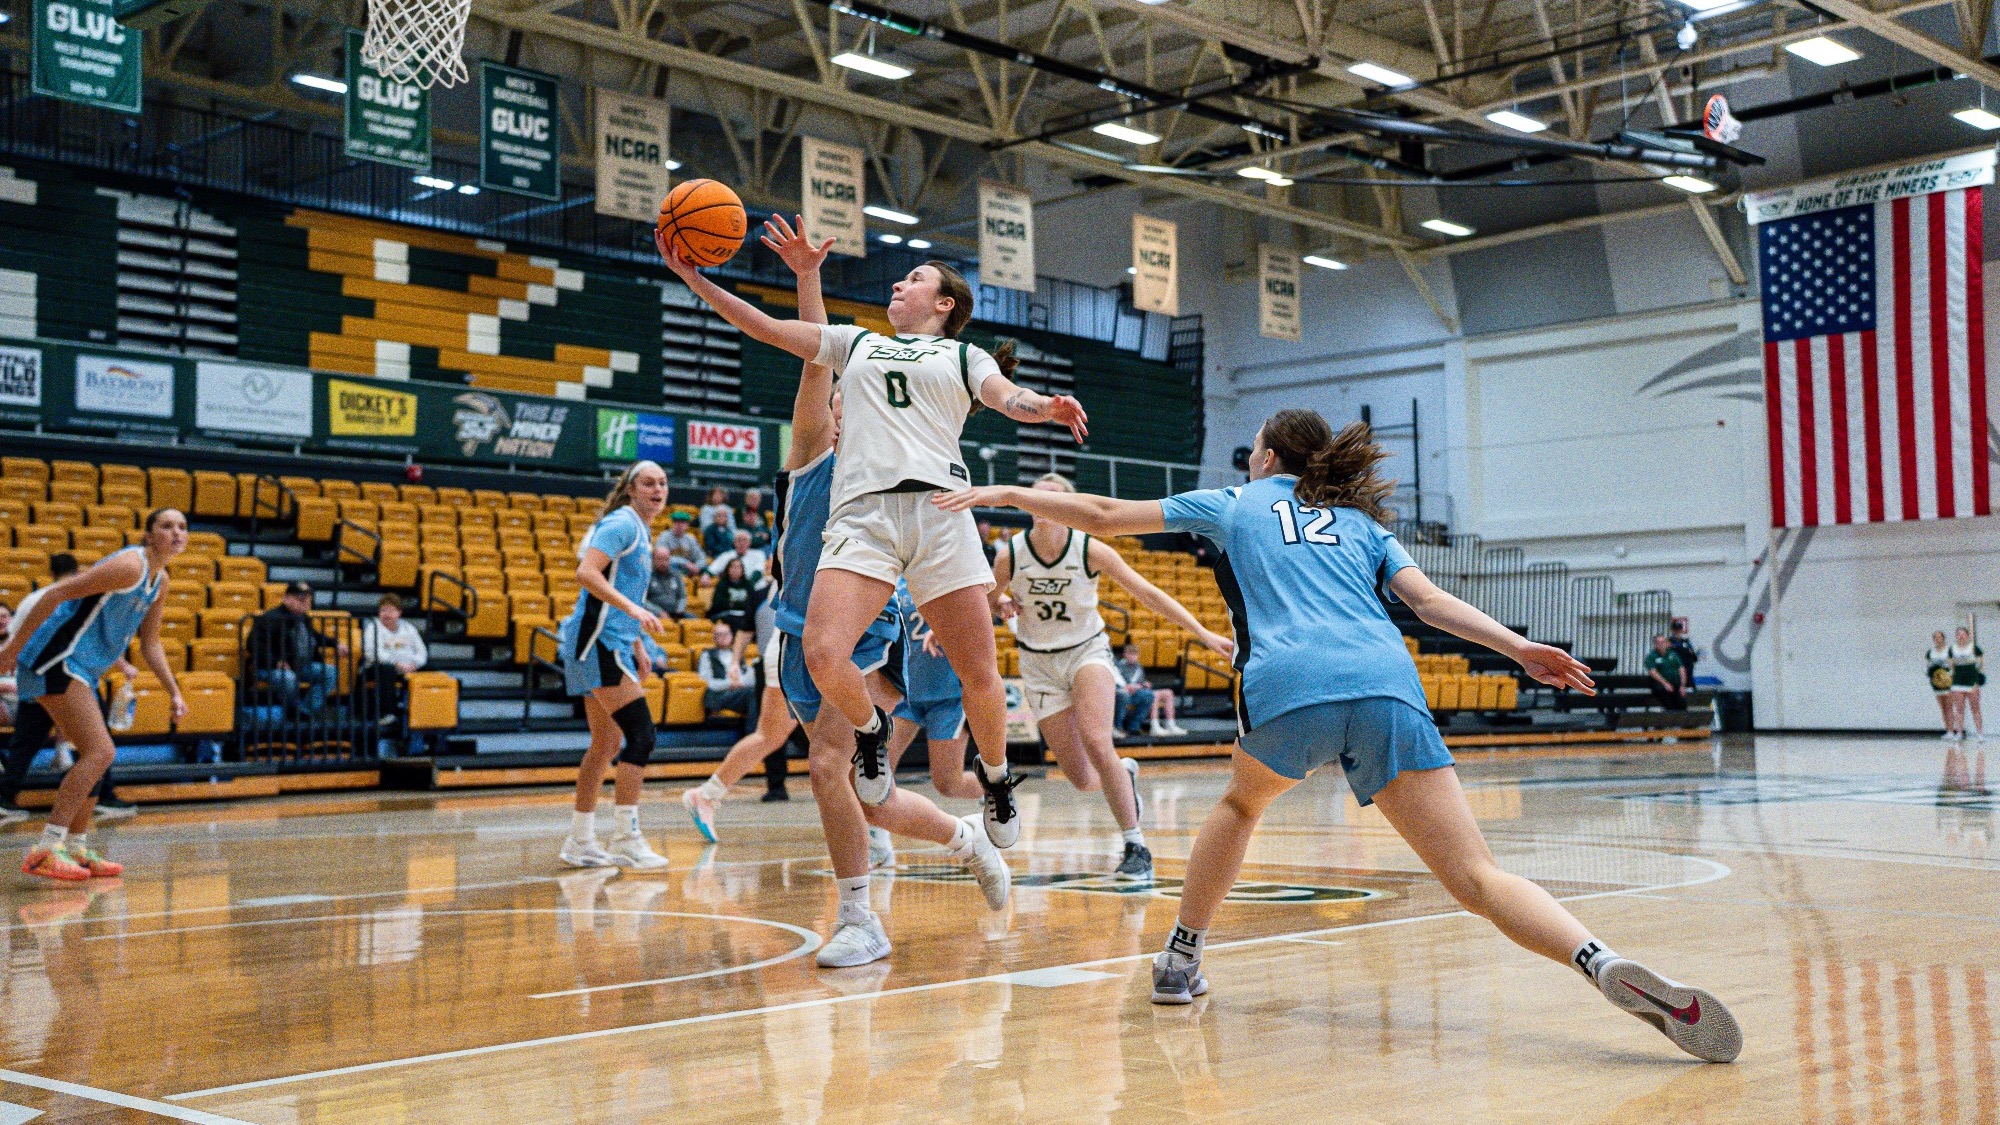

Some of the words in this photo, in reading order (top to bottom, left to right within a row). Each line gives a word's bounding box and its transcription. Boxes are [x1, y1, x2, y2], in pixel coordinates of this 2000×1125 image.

[46, 1, 126, 45] GLVC
[357, 75, 421, 110] GLVC
[491, 107, 550, 142] GLVC
[605, 133, 660, 165] NCAA
[811, 177, 857, 204] NCAA
[1794, 193, 1831, 214] HOME
[1835, 190, 1852, 207] OF
[1855, 184, 1882, 204] THE
[1884, 175, 1940, 197] MINERS
[986, 216, 1027, 241] NCAA
[867, 345, 938, 362] S&T
[339, 390, 409, 417] DICKEY'S
[885, 370, 912, 408] 0
[689, 424, 756, 452] IMO'S
[1270, 499, 1341, 547] 12
[1027, 578, 1071, 595] S&T
[1034, 600, 1072, 622] 32
